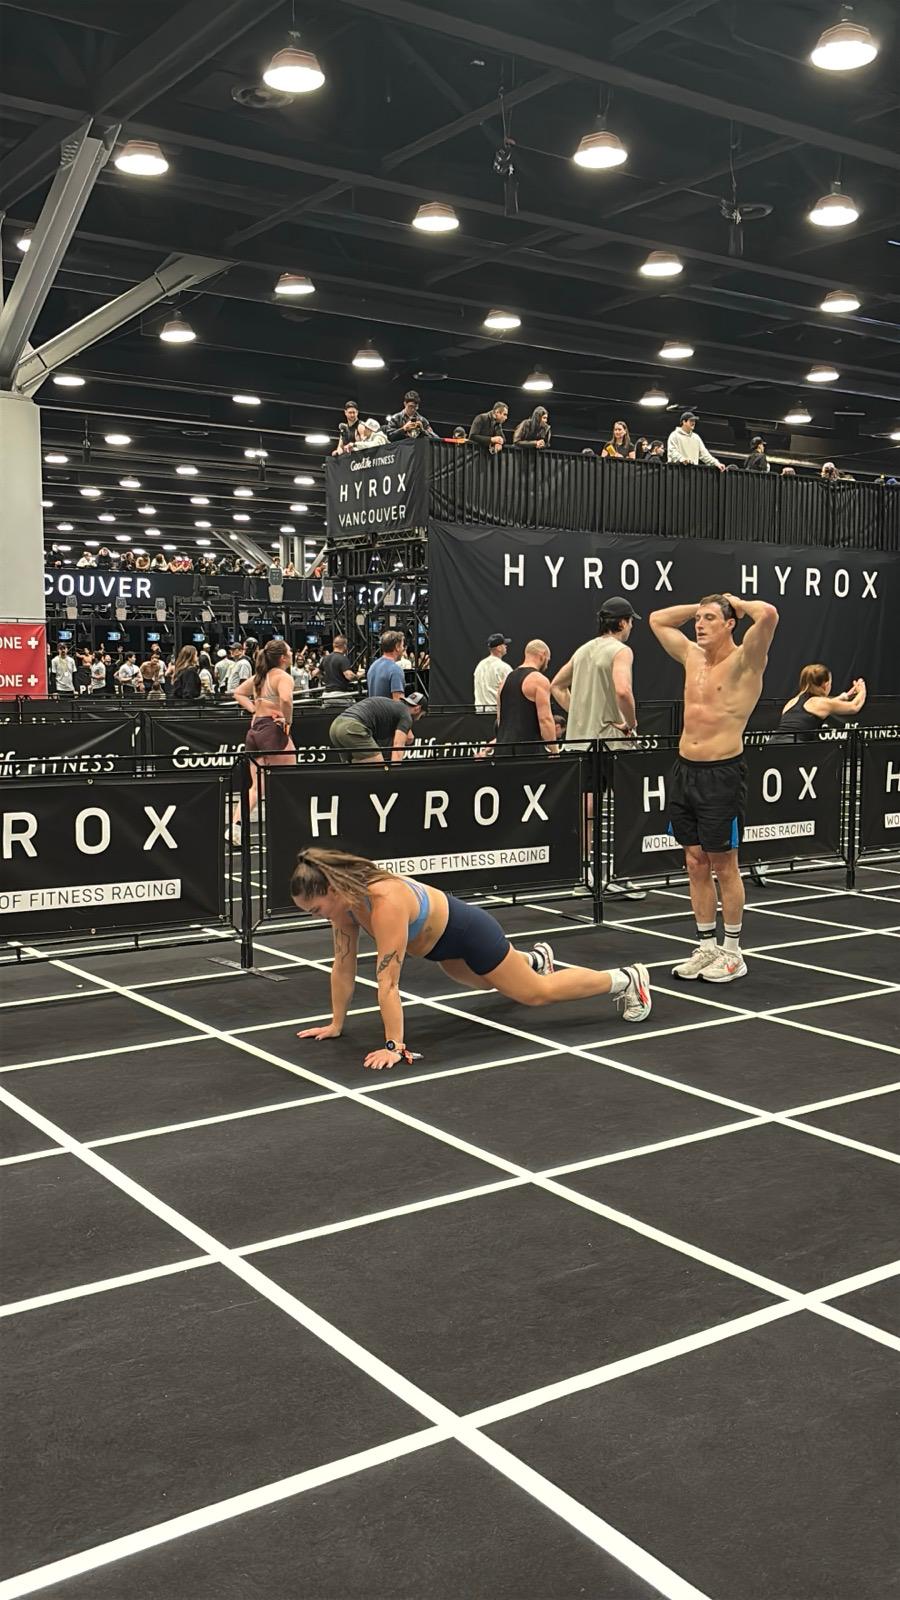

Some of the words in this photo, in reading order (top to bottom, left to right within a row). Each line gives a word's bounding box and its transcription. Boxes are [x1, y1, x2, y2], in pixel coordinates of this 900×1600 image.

[372, 454, 396, 467] FITNESS
[339, 472, 406, 502] HYROX
[338, 504, 406, 527] VANCOUVER
[503, 553, 674, 592] HYROX
[740, 564, 879, 599] HYROX
[310, 783, 549, 837] HYROX
[779, 822, 812, 836] RACING
[420, 858, 436, 871] OF
[441, 853, 496, 869] FITNESS
[500, 848, 546, 864] RACING
[29, 887, 105, 907] FITNESS
[111, 882, 177, 900] RACING
